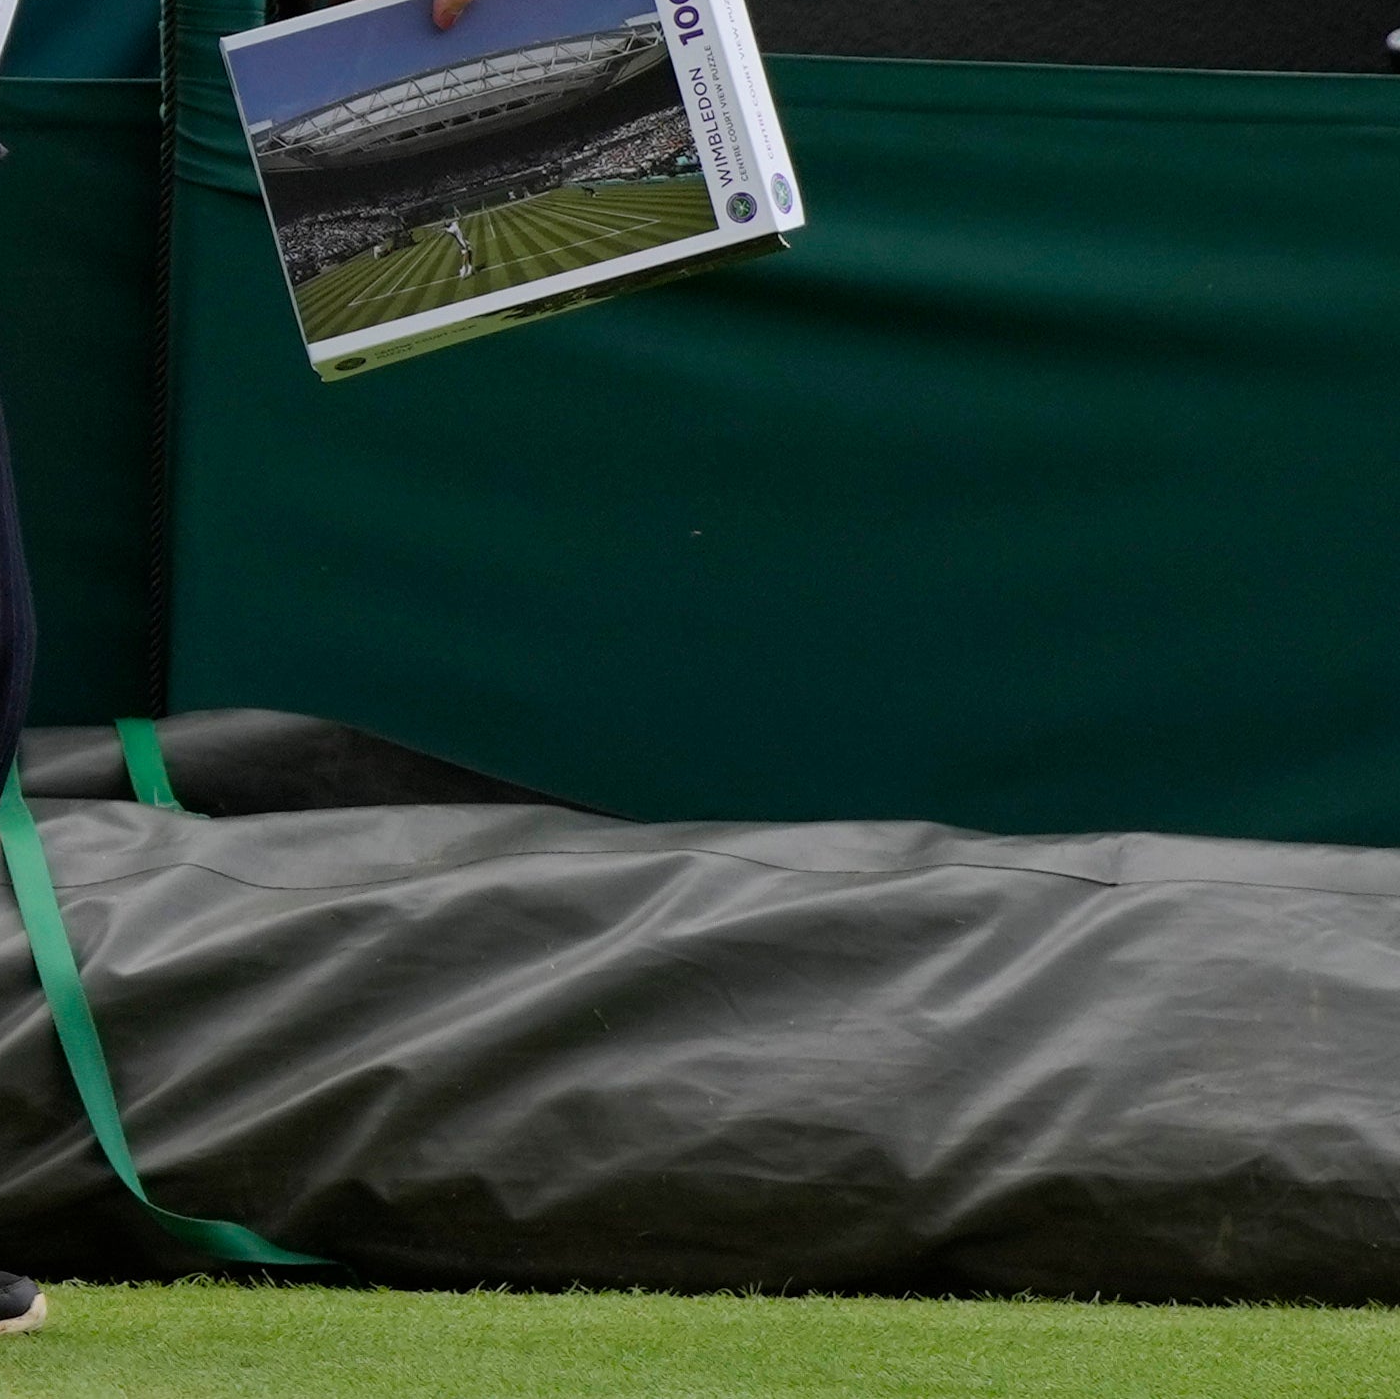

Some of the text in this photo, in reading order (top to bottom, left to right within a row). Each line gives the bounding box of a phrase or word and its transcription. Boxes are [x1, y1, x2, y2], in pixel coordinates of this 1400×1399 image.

[688, 67, 734, 188] WIMBLEDON
[703, 44, 749, 182] CENTRE COURT VIEW PUZZLE
